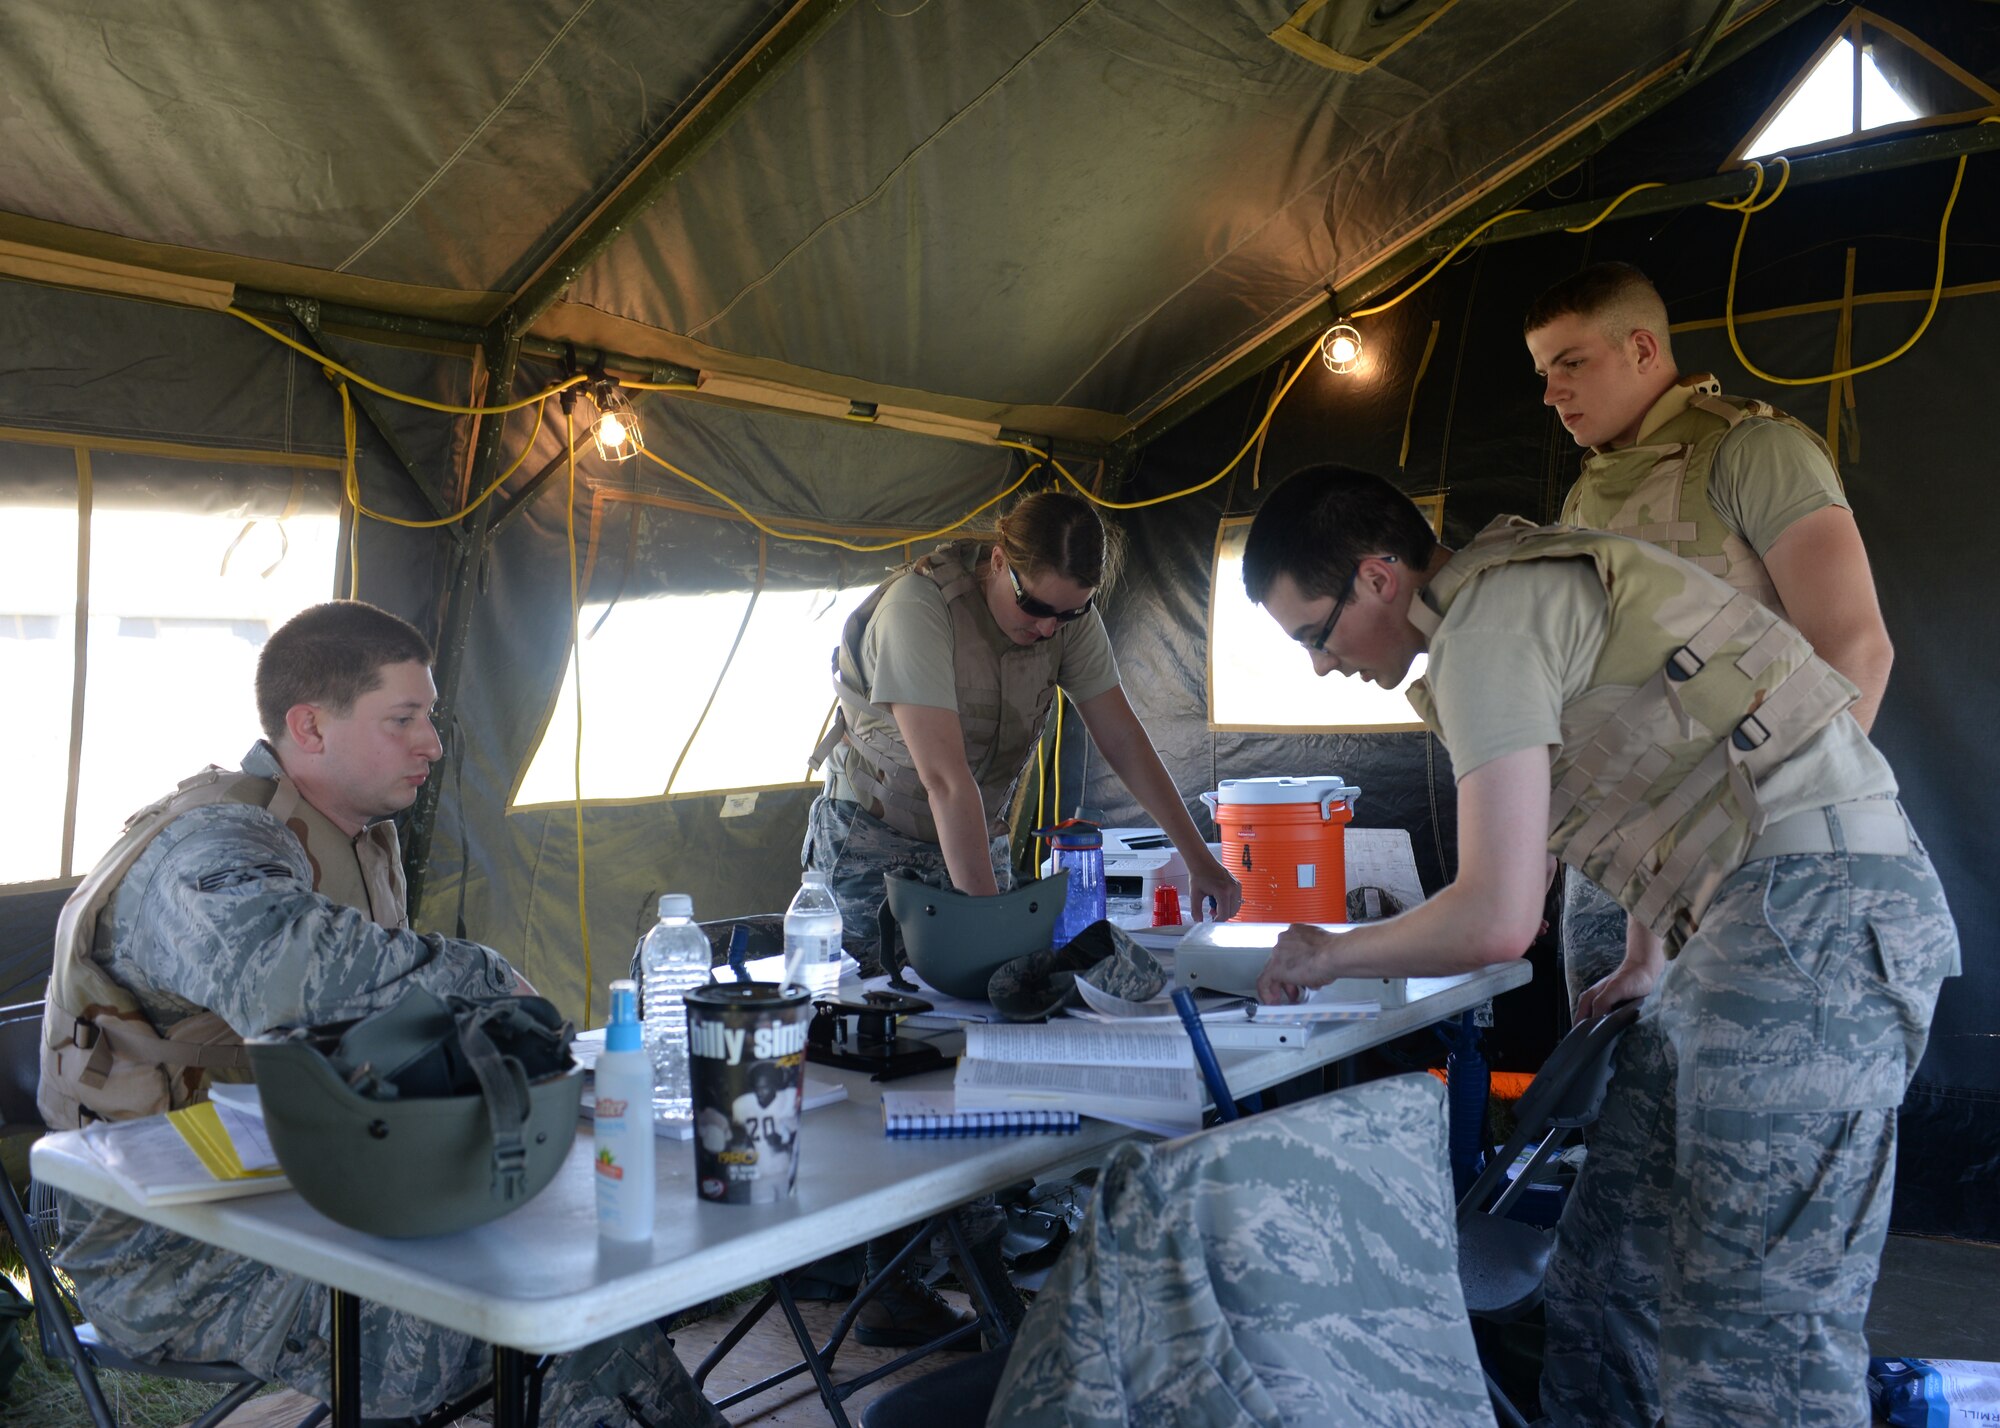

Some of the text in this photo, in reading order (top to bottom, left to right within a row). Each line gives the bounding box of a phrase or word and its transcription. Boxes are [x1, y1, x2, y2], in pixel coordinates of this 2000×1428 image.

[1242, 844, 1253, 872] 4
[690, 1018, 746, 1066] billy
[746, 1116, 775, 1142] 20
